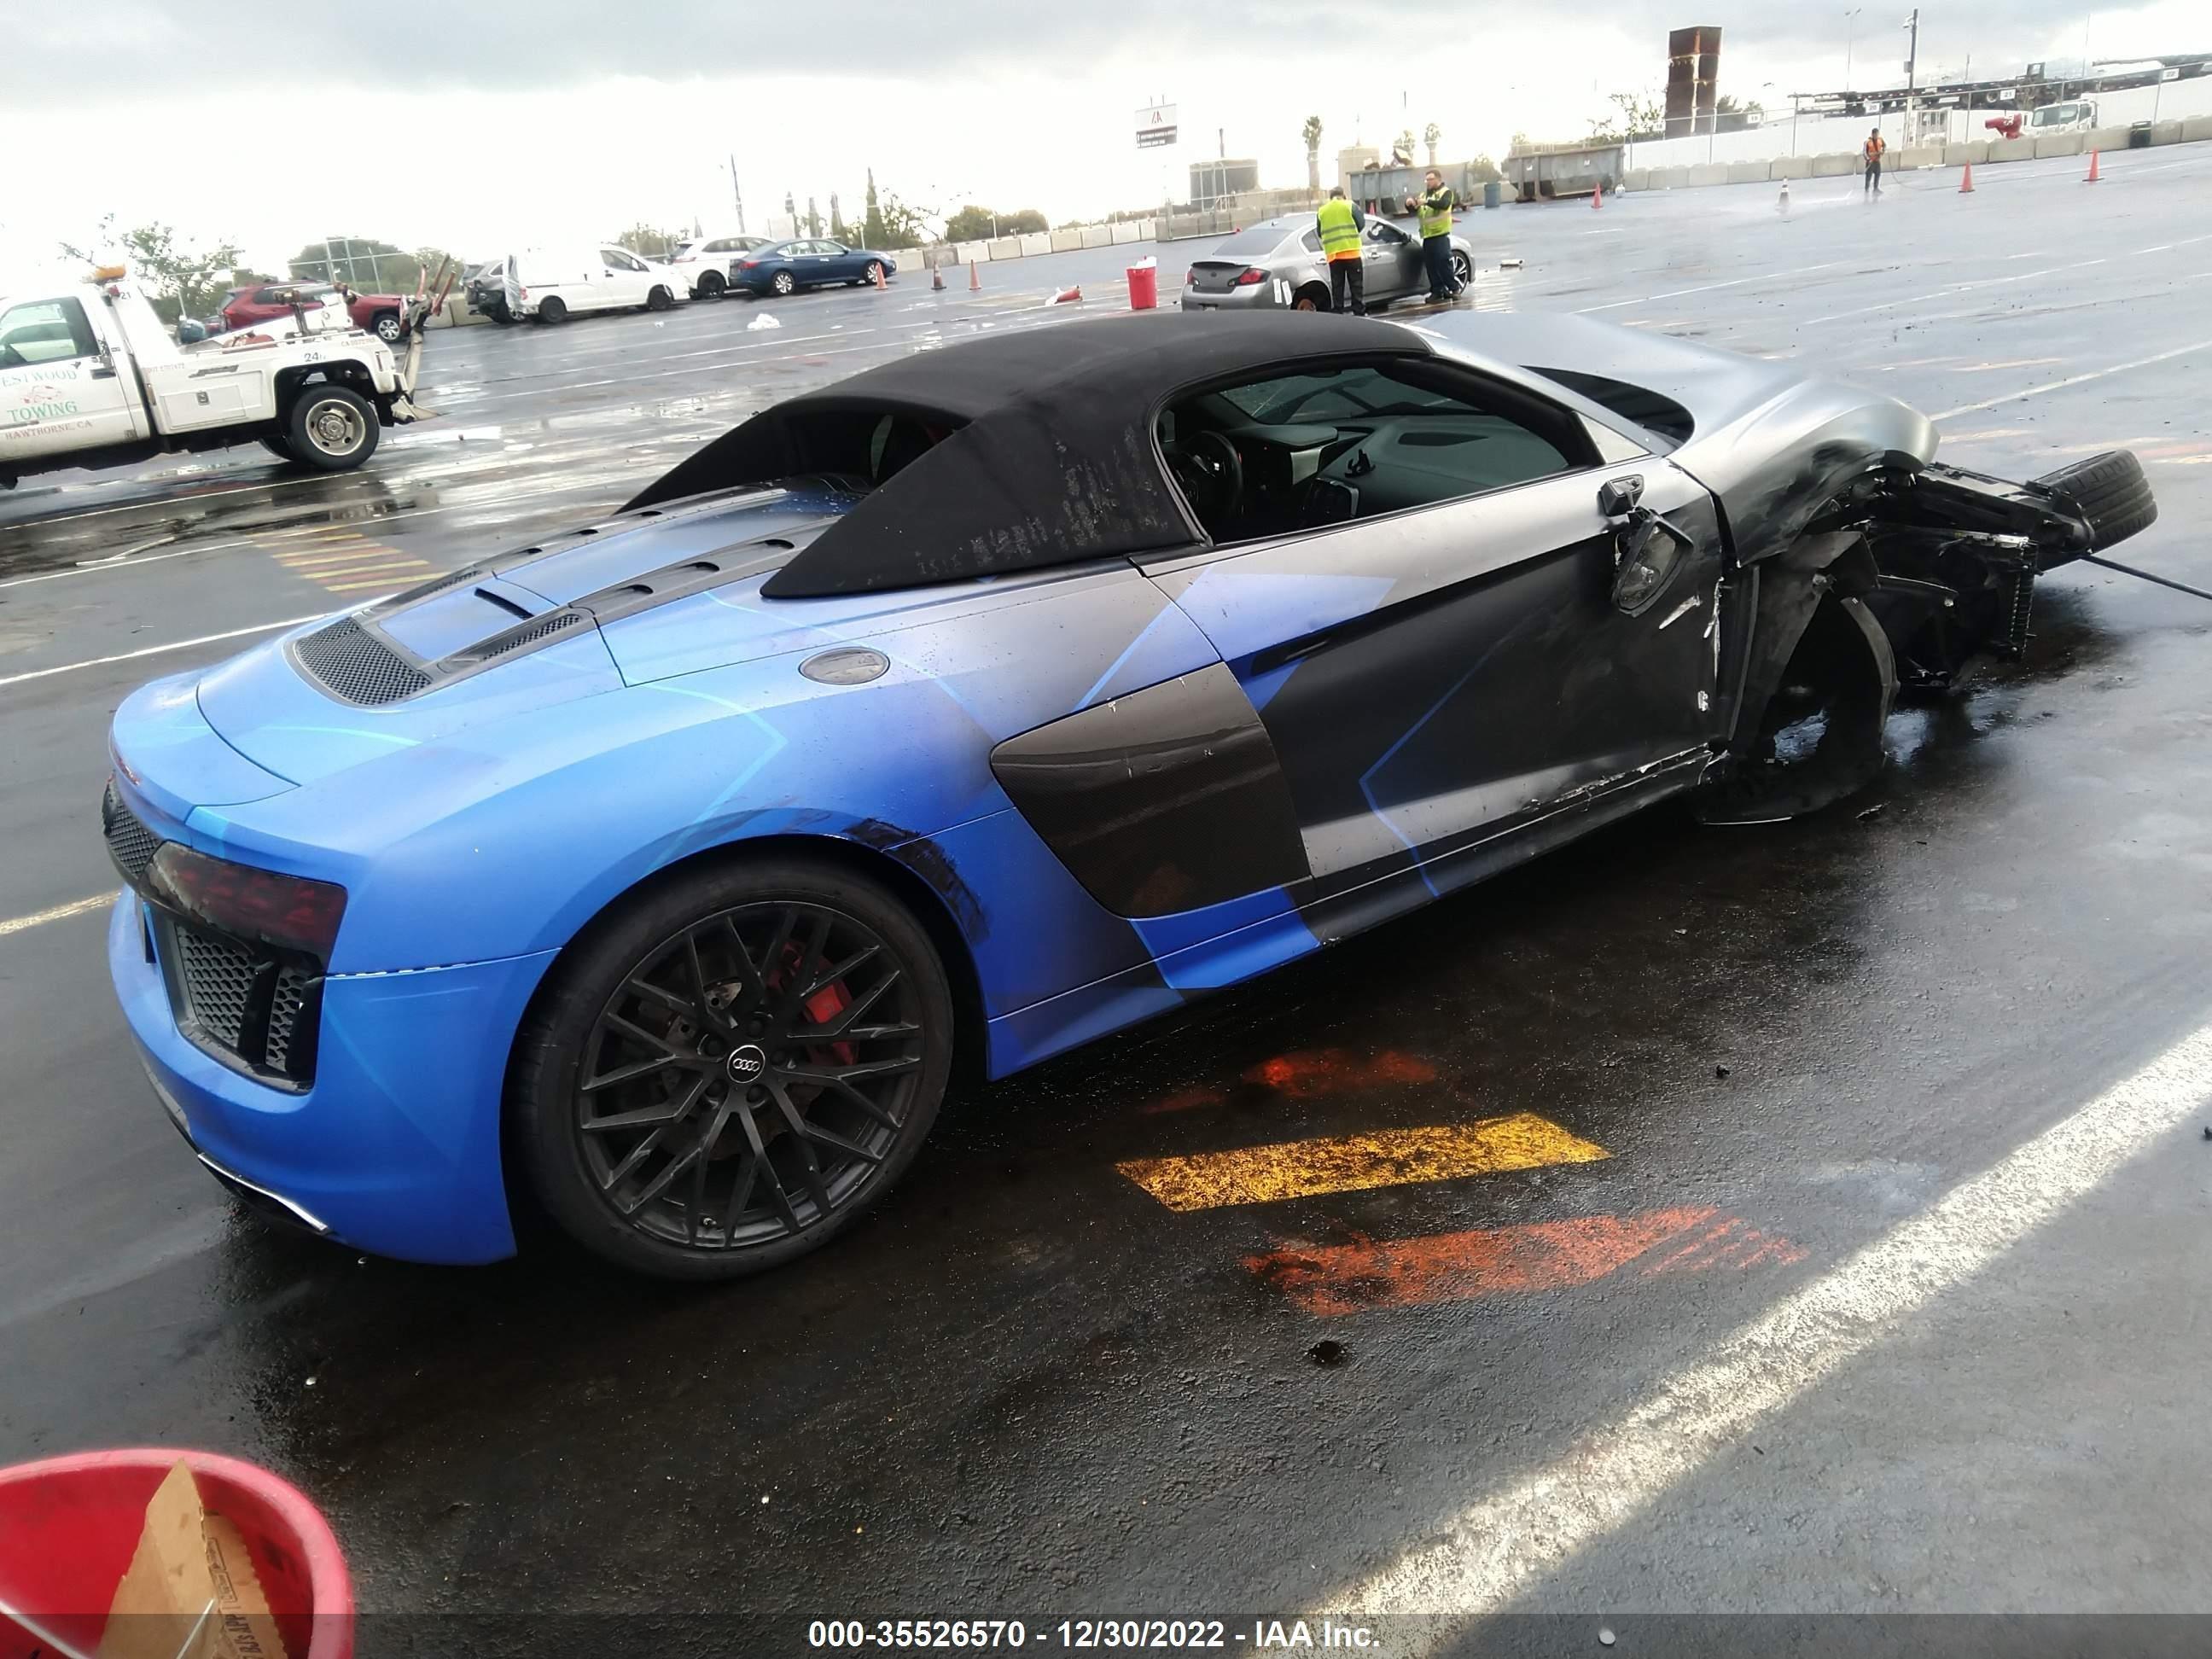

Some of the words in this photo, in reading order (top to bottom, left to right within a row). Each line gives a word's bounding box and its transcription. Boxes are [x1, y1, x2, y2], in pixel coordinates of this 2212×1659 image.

[0, 370, 78, 387] ESTWOOD
[7, 400, 78, 422] TOWING
[77, 419, 93, 428] CA
